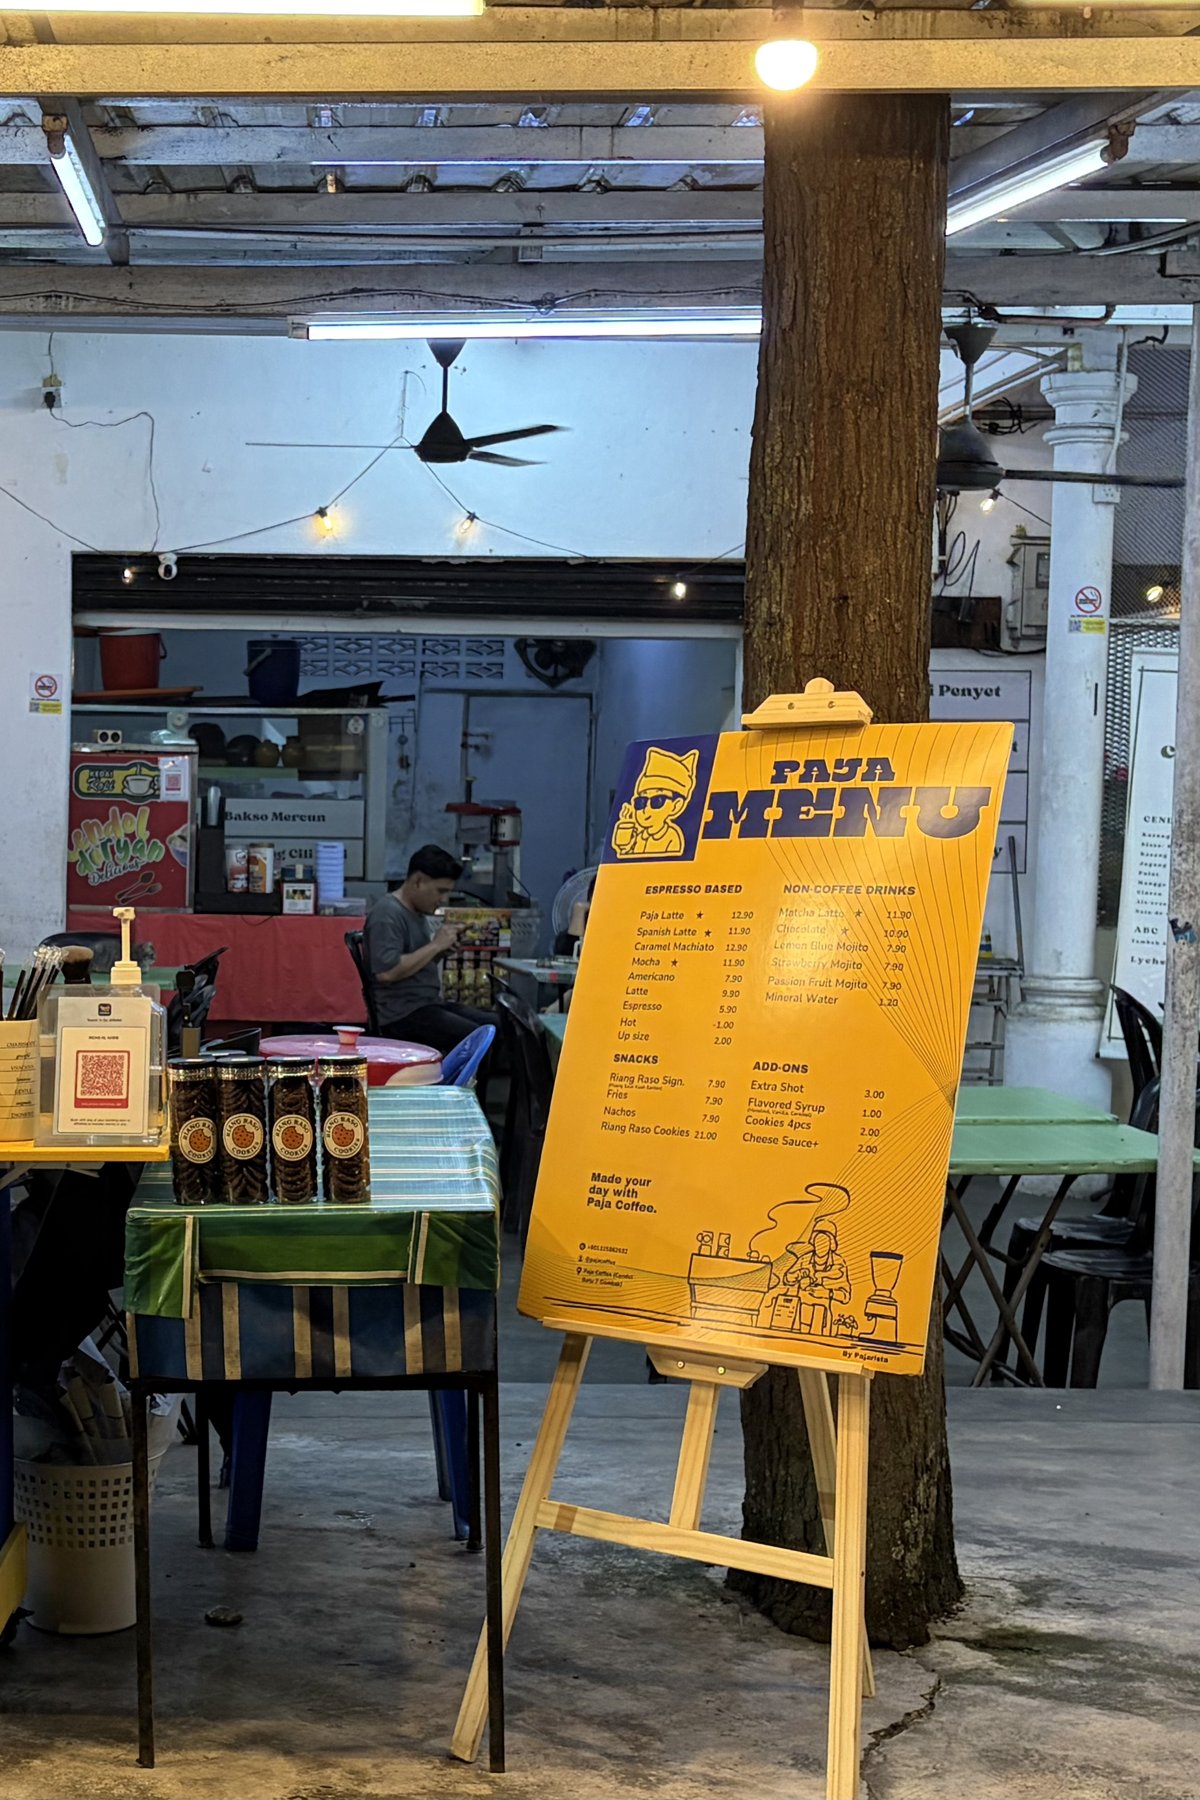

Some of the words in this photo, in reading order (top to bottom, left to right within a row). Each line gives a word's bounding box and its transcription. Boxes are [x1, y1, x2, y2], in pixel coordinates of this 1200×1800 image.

[938, 684, 1001, 700] Penyet
[770, 757, 896, 784] PAJA
[225, 811, 268, 822] Bakso
[271, 811, 326, 822] Mercun
[702, 786, 993, 839] MENU
[289, 848, 313, 859] Cili
[645, 885, 701, 894] ESPRESSO
[704, 884, 742, 894] BASED
[783, 884, 862, 894] NON-COFFEE
[865, 885, 916, 896] DRINKS
[640, 911, 659, 922] Paja
[661, 911, 684, 920] Latte
[731, 911, 754, 920] 12.90
[778, 907, 815, 918] Matcha
[818, 908, 845, 918] Latte
[886, 911, 912, 920] 11.90
[637, 927, 670, 938] Spanish
[673, 927, 697, 937] Latte
[728, 927, 751, 936] 11.90
[776, 924, 826, 934] Chocolate
[1134, 926, 1158, 935] ABC
[634, 942, 671, 951] Caramel
[673, 942, 715, 952] Machiato
[725, 944, 747, 952] 12.90
[774, 940, 807, 950] Lemon
[810, 941, 834, 951] Blue
[836, 942, 869, 953] Mojito
[886, 945, 907, 953] 7.90
[631, 957, 660, 967] Mocha
[723, 959, 745, 967] 11.90
[771, 957, 827, 969] Strawberry
[830, 960, 863, 971] Mojito
[883, 963, 904, 971] 7.90
[627, 972, 675, 982] Americano
[724, 975, 743, 983] 7.90
[767, 976, 806, 987] Passion
[808, 977, 832, 987] Fruit
[835, 979, 868, 990] Mojito
[882, 982, 902, 990] 7.90
[625, 986, 649, 996] Latte
[721, 990, 740, 998] 9.90
[765, 992, 802, 1003] Mineral
[806, 994, 839, 1005] Water
[878, 999, 899, 1007] 1.20
[622, 1001, 662, 1012] Espresso
[719, 1005, 737, 1013] 5.90
[620, 1017, 637, 1027] Hot
[713, 1021, 734, 1029] -1.00
[617, 1031, 631, 1042] Up
[632, 1031, 650, 1041] size
[714, 1037, 732, 1045] 2.00
[613, 1053, 659, 1064] SNACKS
[752, 1061, 809, 1074] ADD-ONS
[609, 1072, 635, 1085] Riang
[637, 1074, 660, 1085] Raso
[662, 1075, 685, 1087] Sign.
[708, 1080, 726, 1089] 7.90
[750, 1080, 777, 1092] Extra
[780, 1082, 805, 1094] Shot
[864, 1090, 885, 1099] 3.00
[606, 1088, 628, 1099] Fries
[705, 1096, 723, 1106] 7.90
[748, 1098, 792, 1110] Flavored
[794, 1100, 825, 1114] Syrup
[862, 1109, 882, 1118] 1.00
[603, 1106, 636, 1117] Nachos
[702, 1114, 720, 1124] 7.90
[243, 1118, 260, 1132] RASO
[293, 1120, 310, 1134] RASO
[340, 1117, 359, 1129] RASO
[745, 1115, 784, 1127] Cookies
[787, 1119, 812, 1130] 4pcs
[860, 1127, 880, 1137] 2.00
[601, 1121, 627, 1134] Riang
[628, 1123, 651, 1134] Raso
[653, 1125, 690, 1138] Cookies
[694, 1131, 717, 1140] 21.00
[742, 1132, 779, 1145] Cheese
[782, 1135, 819, 1148] Sauce+
[857, 1144, 878, 1154] 2.00
[591, 1172, 622, 1184] Made
[625, 1177, 652, 1187] your
[589, 1185, 609, 1197] day
[613, 1187, 638, 1199] with
[587, 1196, 612, 1210] Paja
[615, 1200, 657, 1213] Coffee.
[842, 1350, 853, 1359] By
